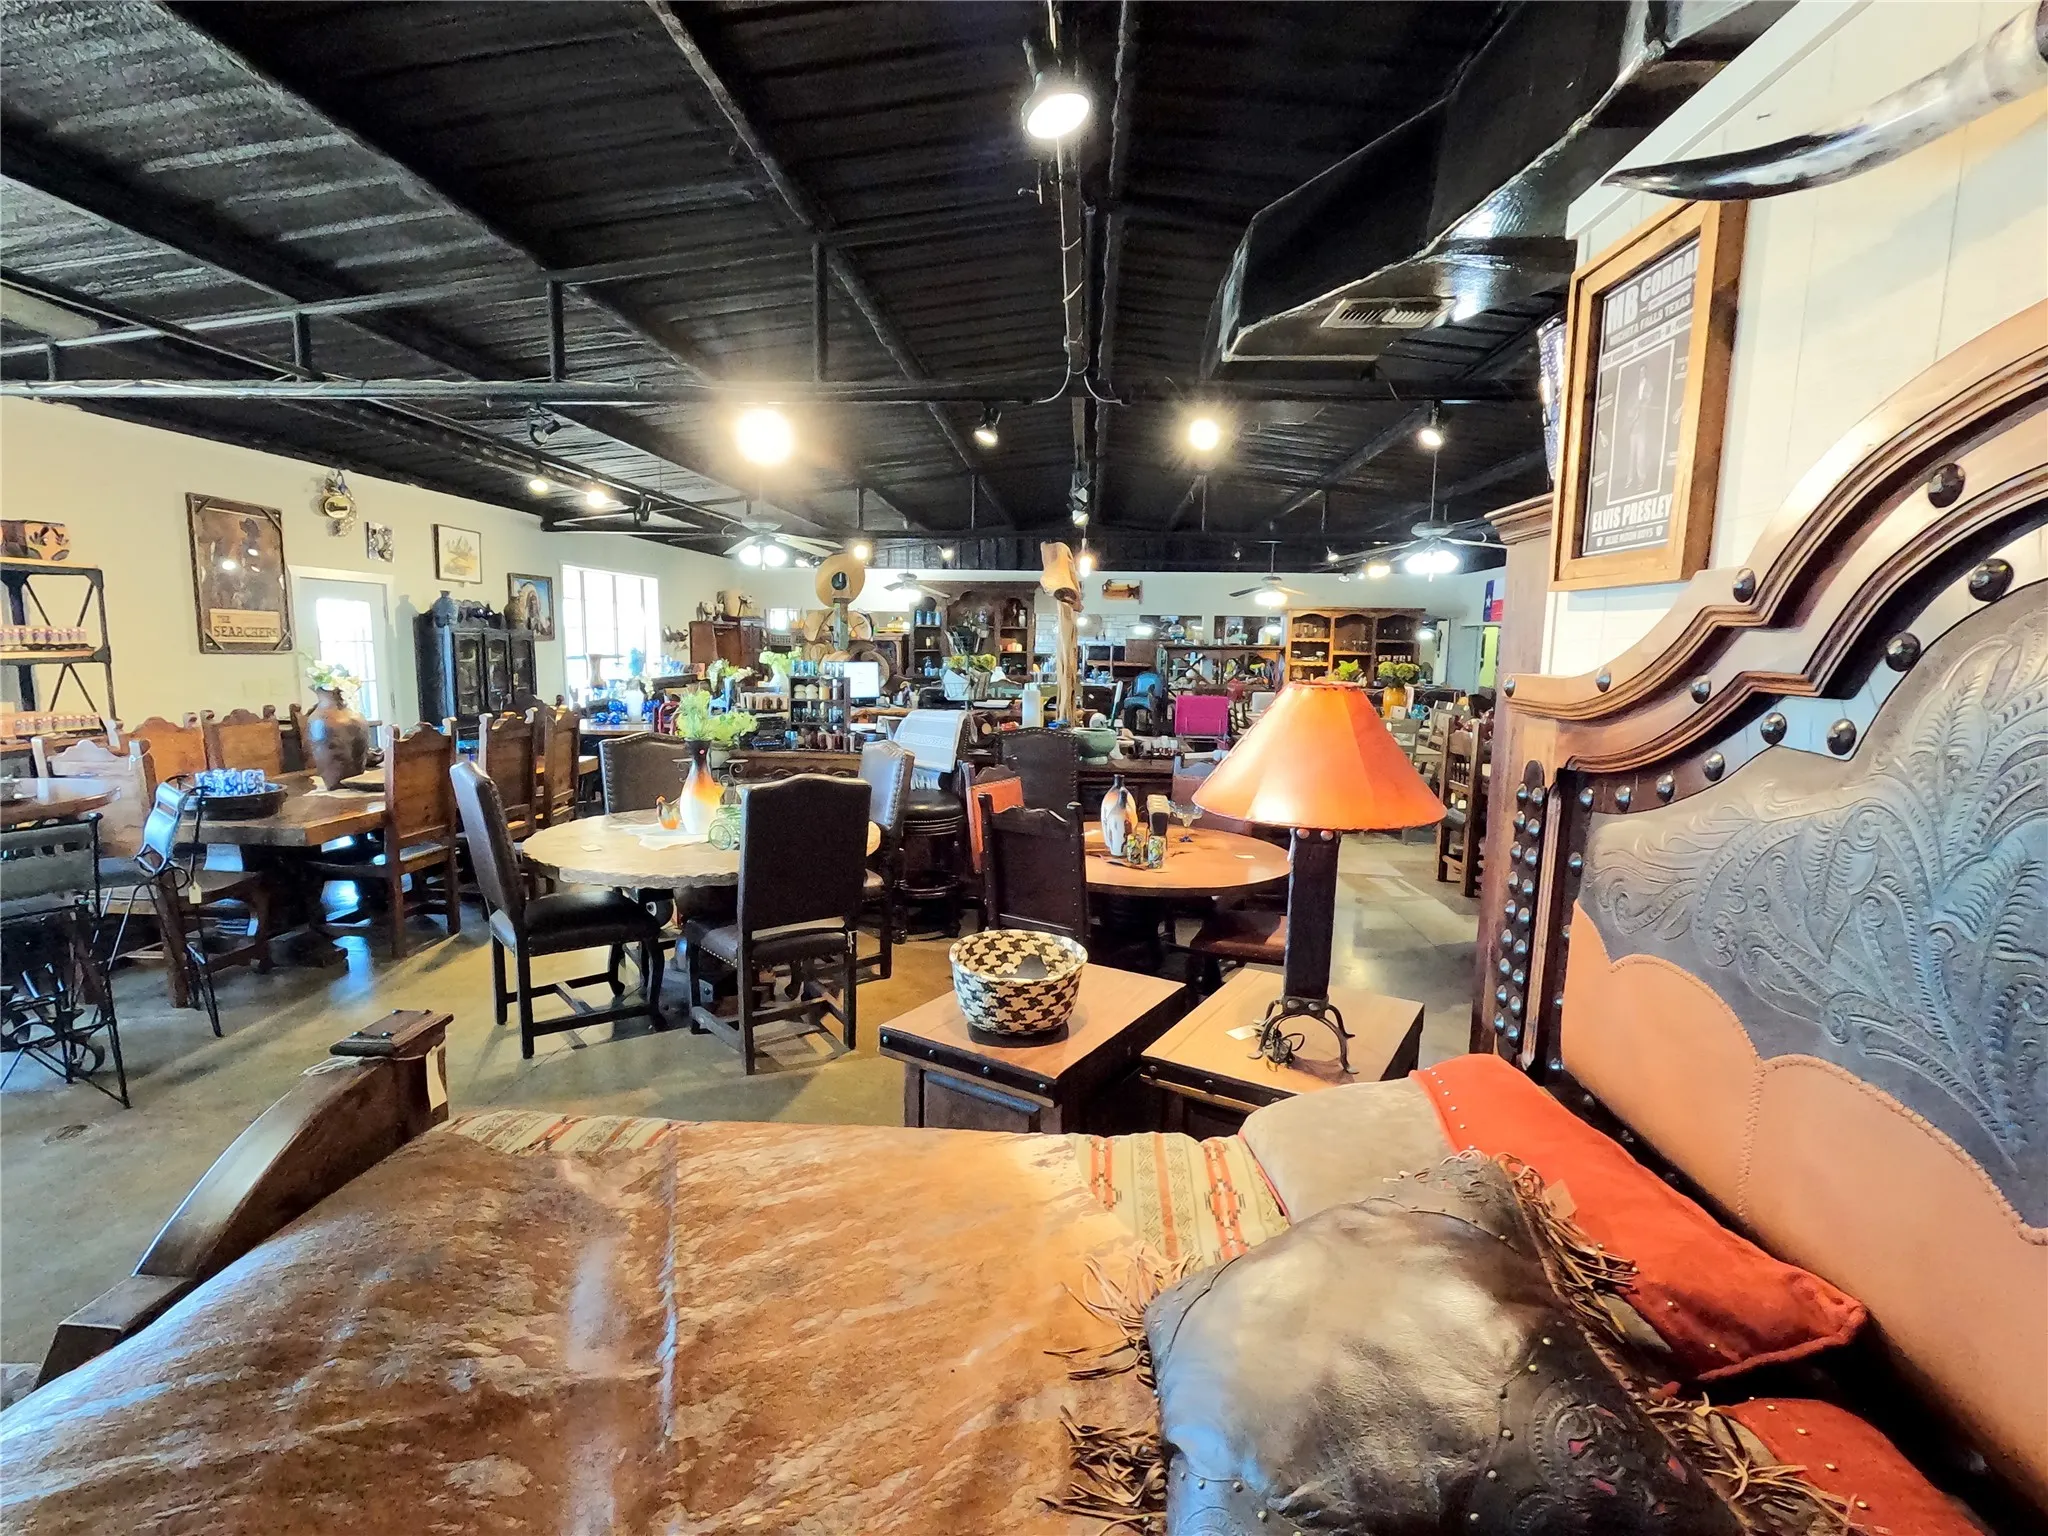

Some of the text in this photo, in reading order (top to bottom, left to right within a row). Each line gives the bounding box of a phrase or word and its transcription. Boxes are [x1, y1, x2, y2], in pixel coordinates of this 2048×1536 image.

[1664, 293, 1691, 317] TEXAS
[1592, 493, 1673, 533] ELVIS PRESLEY
[213, 625, 279, 638] SEARCHERS
